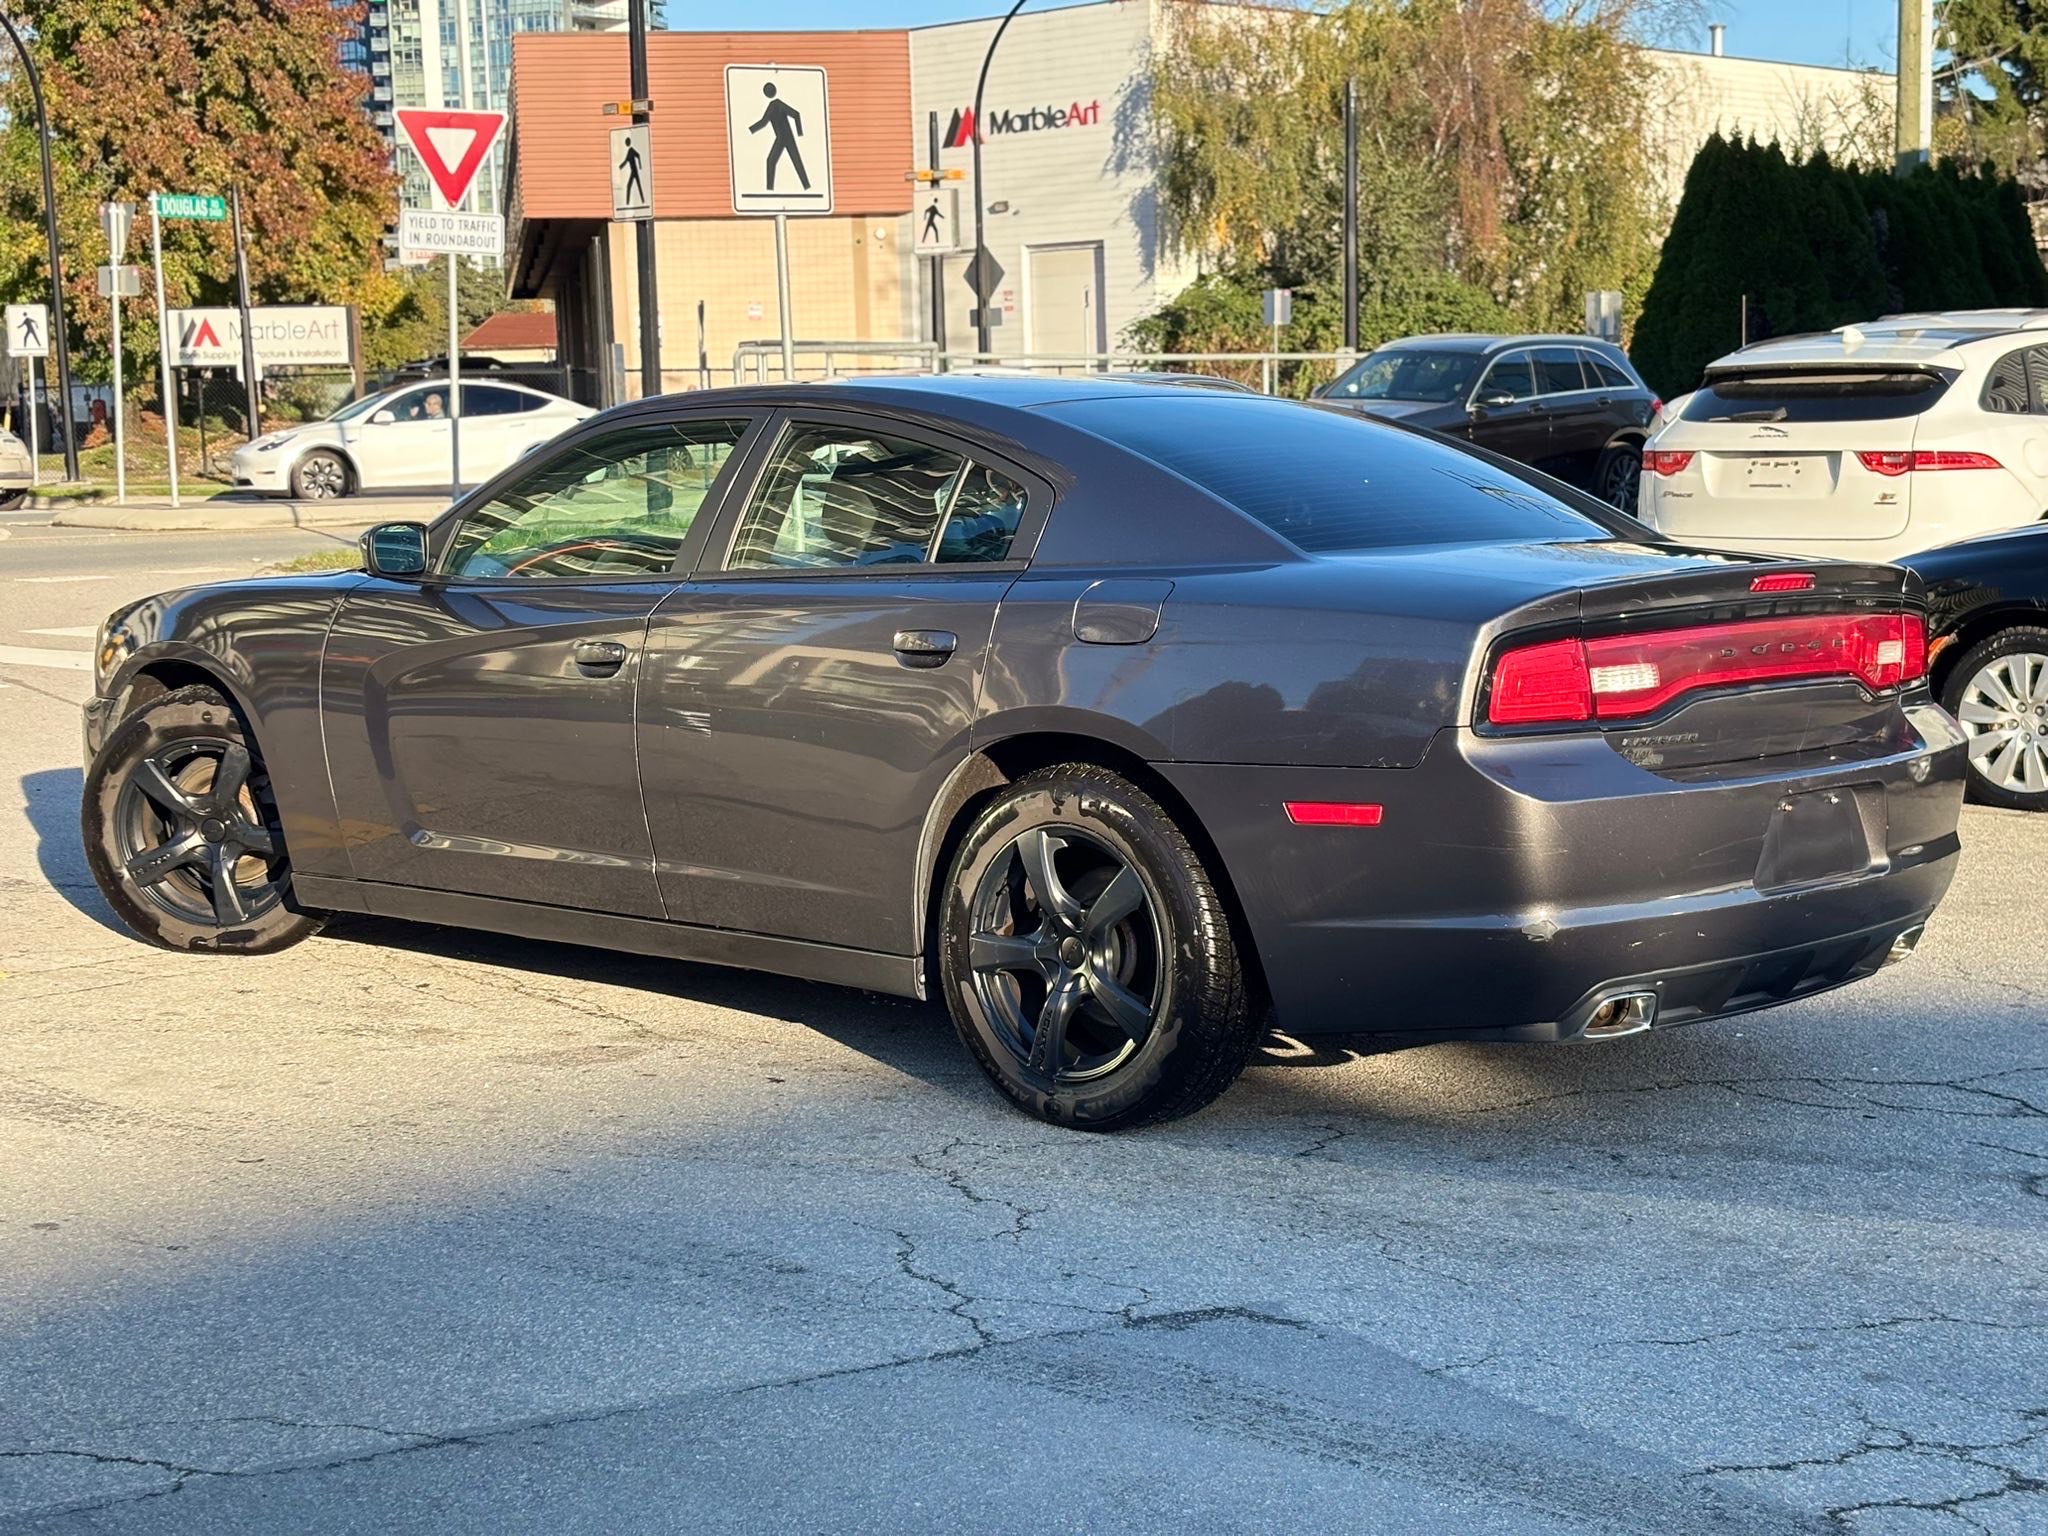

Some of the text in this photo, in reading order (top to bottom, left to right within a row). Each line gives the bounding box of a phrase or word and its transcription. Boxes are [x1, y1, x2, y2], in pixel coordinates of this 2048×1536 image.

[989, 100, 1100, 135] MarbleArt
[161, 198, 208, 216] DOUGLAS
[409, 216, 497, 233] YIELD TO TRAFFIC
[409, 232, 497, 248] IN ROUNDABOUT
[229, 320, 341, 340] MarbleArt
[1720, 638, 1846, 658] DODGE
